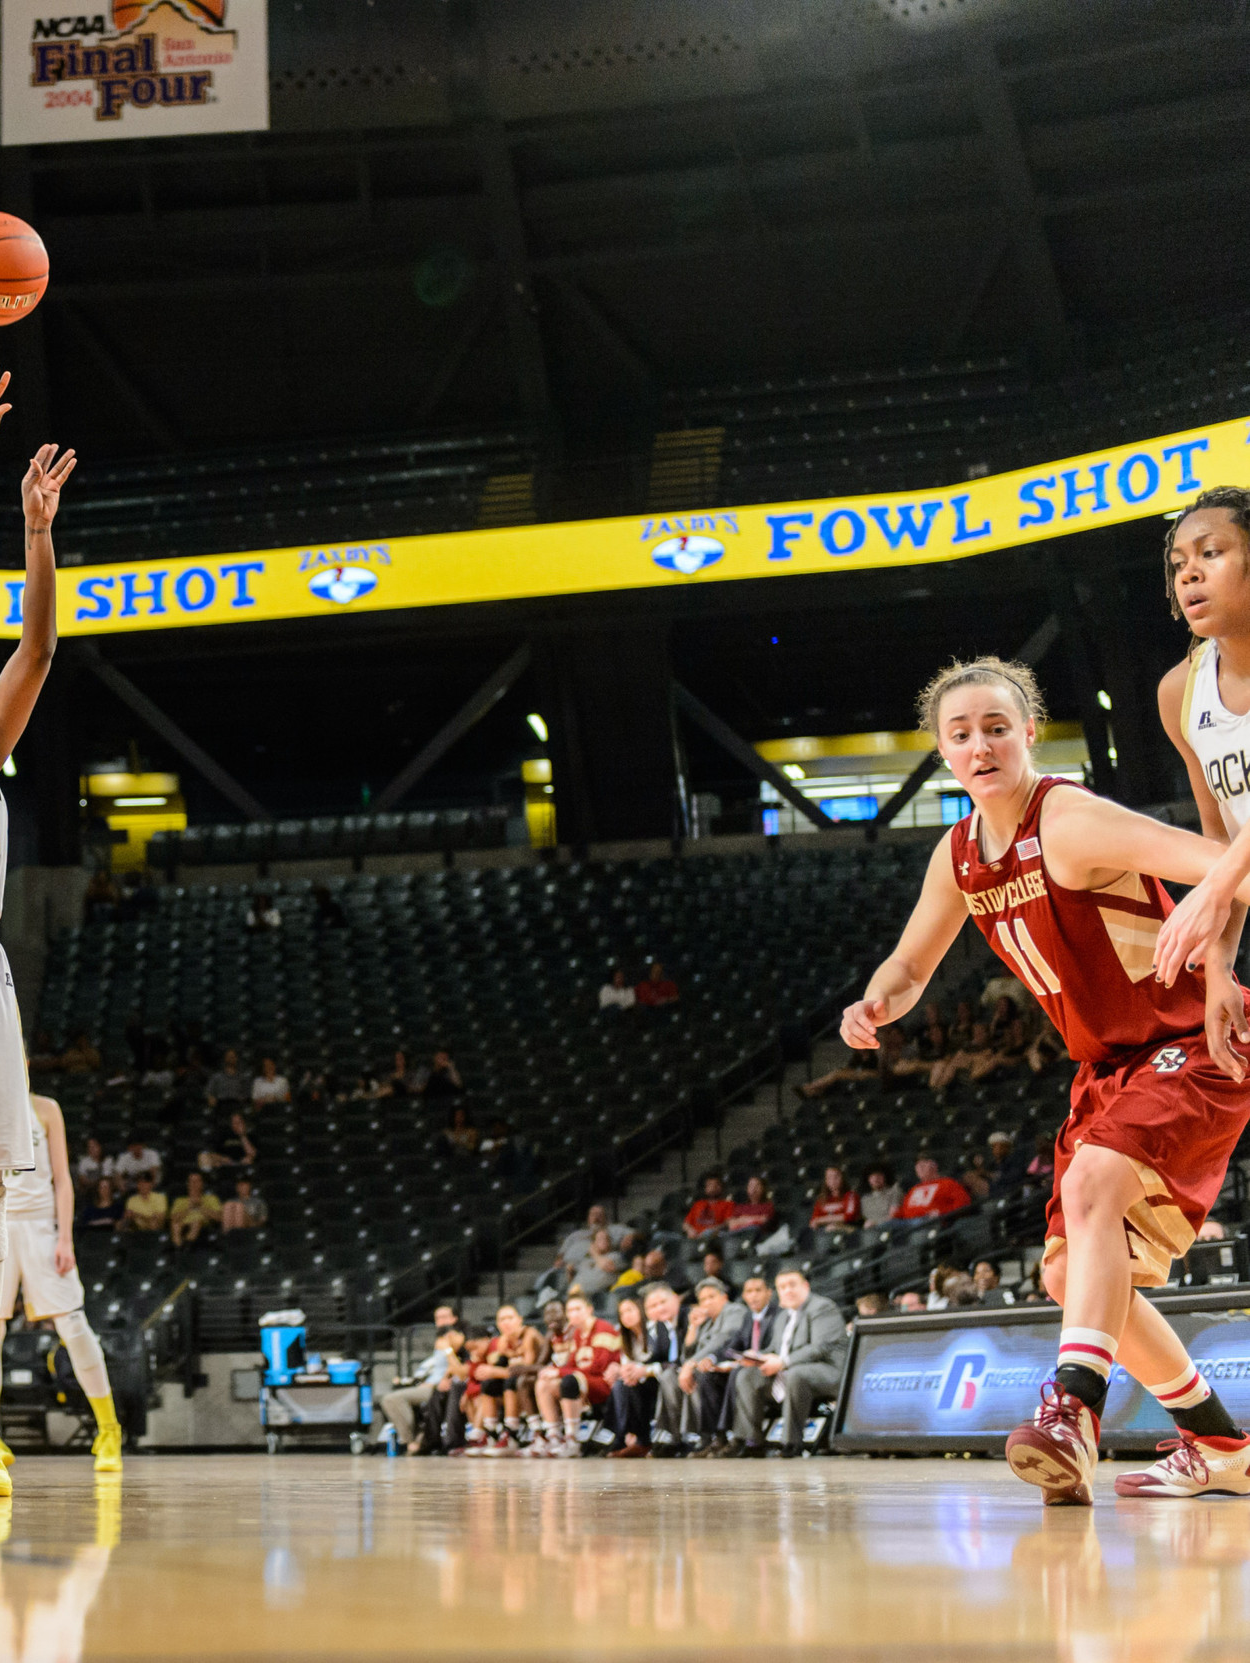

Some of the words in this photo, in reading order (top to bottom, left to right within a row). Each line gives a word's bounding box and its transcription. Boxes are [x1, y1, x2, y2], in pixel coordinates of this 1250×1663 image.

[33, 15, 105, 39] NCAA
[34, 35, 157, 84] Final
[44, 89, 94, 109] 2004
[100, 72, 212, 117] Four
[766, 494, 991, 561] FOWL
[1019, 438, 1209, 529] SHOT
[641, 511, 740, 541] ZAXBY'S
[298, 543, 391, 572] ZAXBY'S
[75, 561, 265, 621] SHOT
[996, 917, 1062, 997] 11
